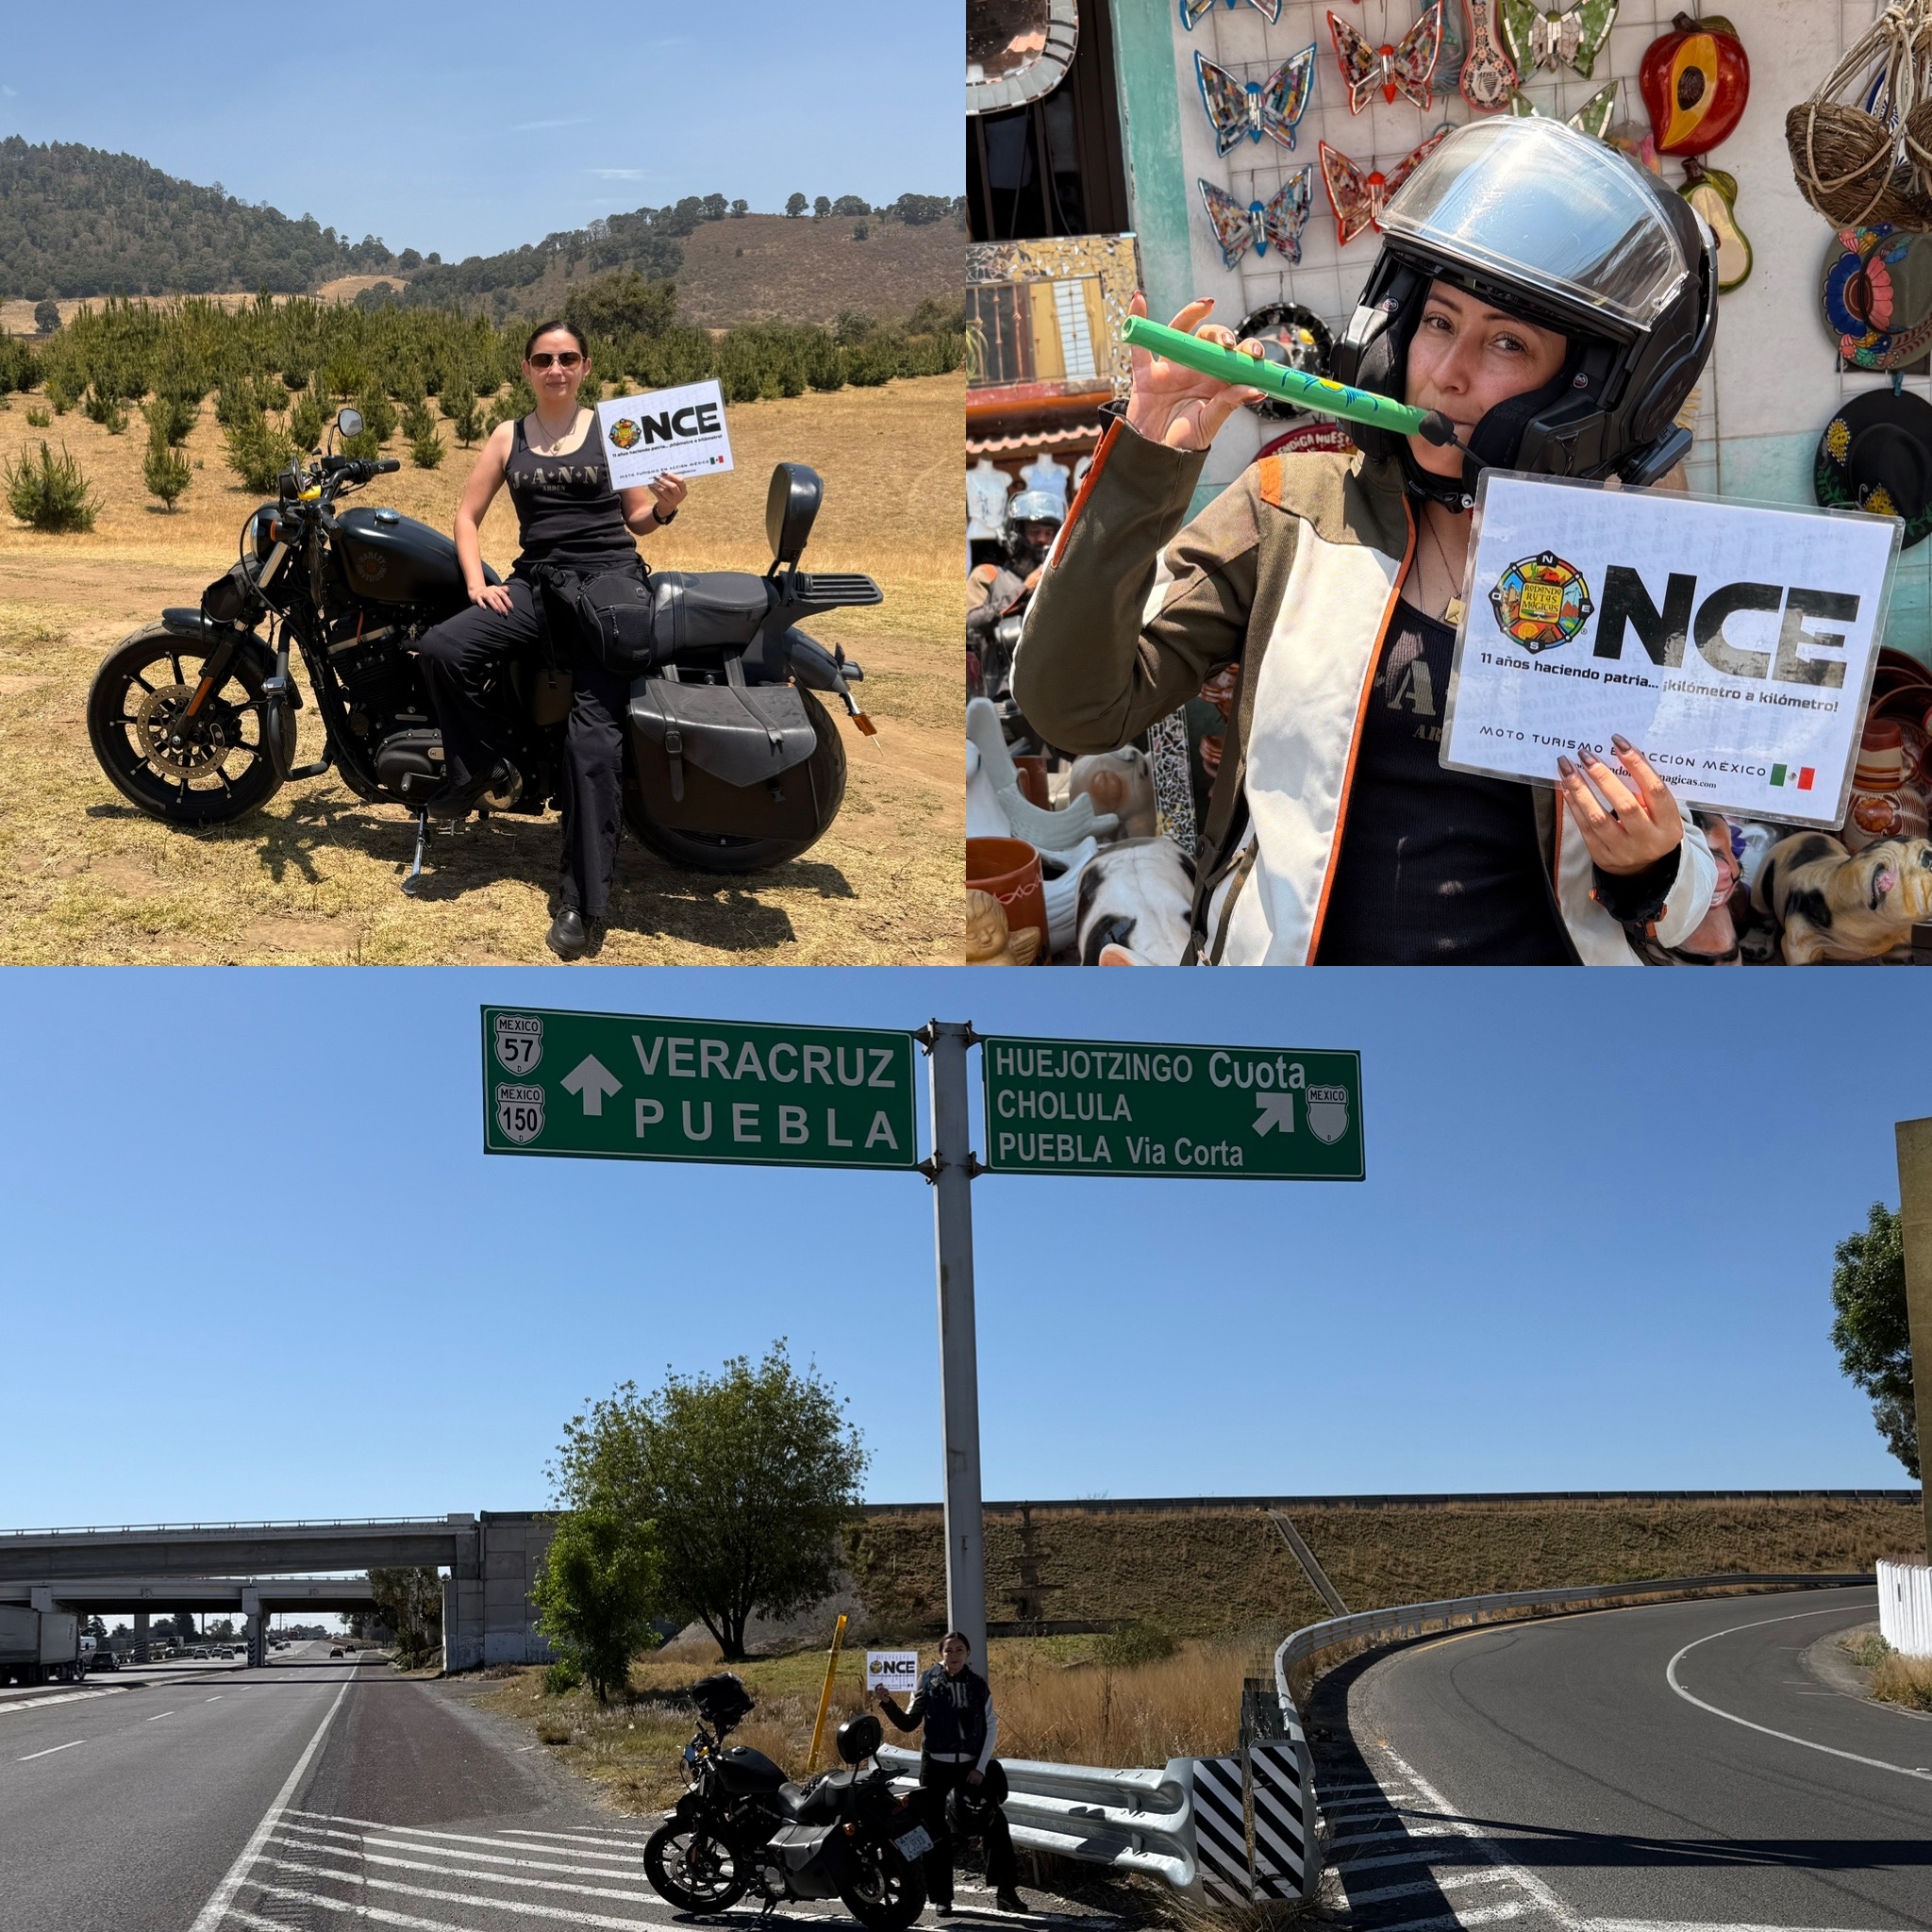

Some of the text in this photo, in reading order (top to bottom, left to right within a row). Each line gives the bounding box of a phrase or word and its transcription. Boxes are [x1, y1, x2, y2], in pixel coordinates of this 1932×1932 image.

[1480, 652, 1492, 664] 11
[1495, 656, 1530, 671] años
[1534, 660, 1600, 680] haciendo
[1604, 672, 1659, 689] patria...
[1745, 691, 1755, 702] a
[1758, 691, 1840, 712] kilómetro!
[1479, 725, 1524, 741] MOTO
[1532, 734, 1604, 754] TURISMO
[1641, 751, 1696, 767] CCIÓN
[1702, 760, 1766, 777] MÉXICO
[499, 1019, 539, 1032] MEXICO
[505, 1038, 534, 1062] 57
[631, 1035, 895, 1089] VERACRUZ
[996, 1047, 1307, 1090] HUEJOTZINGO Cuota
[501, 1088, 541, 1101] MEXICO
[997, 1090, 1132, 1122] CHOLULA
[1309, 1090, 1345, 1102] MEXICO
[503, 1107, 538, 1132] 150
[635, 1098, 899, 1150] PUEBLA
[999, 1132, 1244, 1167] PUEBLA Via Corta
